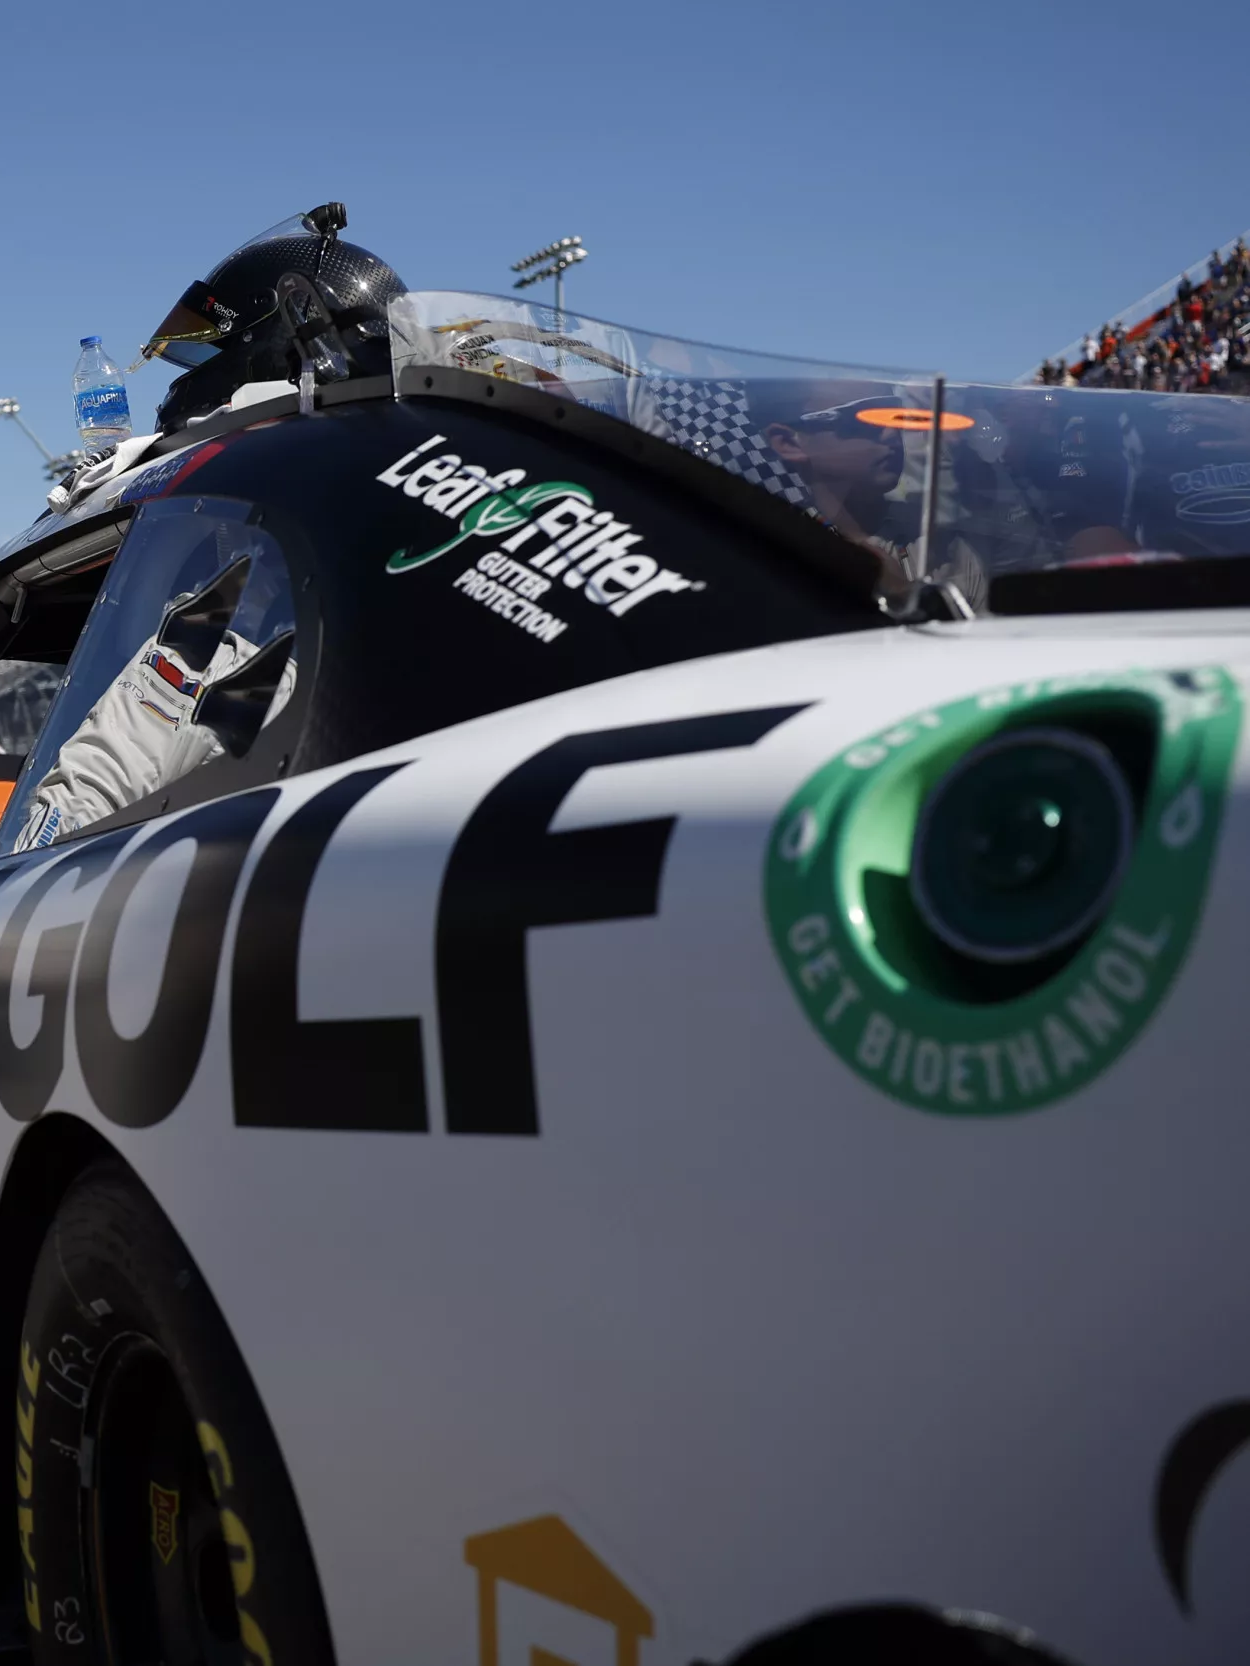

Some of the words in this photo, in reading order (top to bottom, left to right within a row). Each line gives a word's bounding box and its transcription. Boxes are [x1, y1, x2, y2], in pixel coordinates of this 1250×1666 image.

[213, 302, 239, 319] ROWDY
[81, 393, 123, 408] AQUAFINA
[477, 551, 551, 600] GUTTER
[453, 568, 568, 643] PROTECTION
[787, 914, 862, 1024] GET
[856, 914, 1174, 1103] BIOETHANOL
[156, 1494, 170, 1547] AERO
